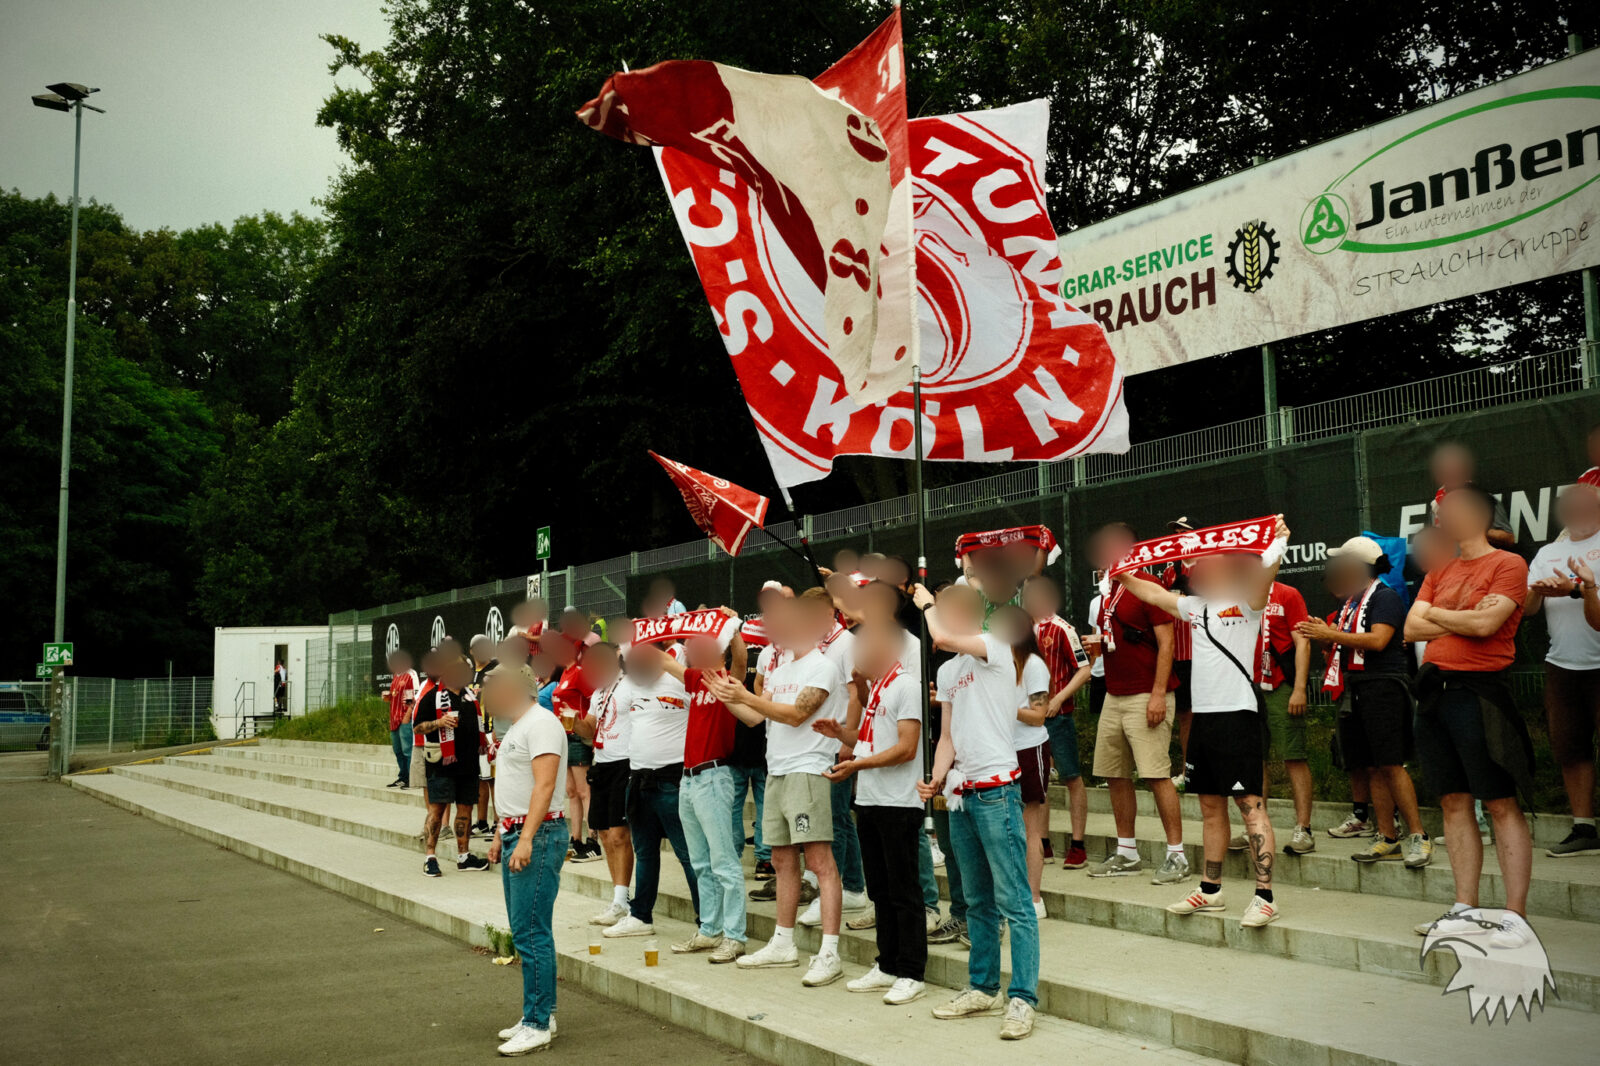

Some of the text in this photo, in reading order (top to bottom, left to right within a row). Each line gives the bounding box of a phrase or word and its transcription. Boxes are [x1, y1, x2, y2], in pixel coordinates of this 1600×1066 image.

[1355, 124, 1600, 231] Janßen
[1385, 184, 1544, 240] Ein unternehmen der
[1059, 234, 1213, 299] GRAR-SERVICE
[1353, 221, 1590, 296] STRAUCH-Gruppe
[802, 364, 1085, 461] KÖLN
